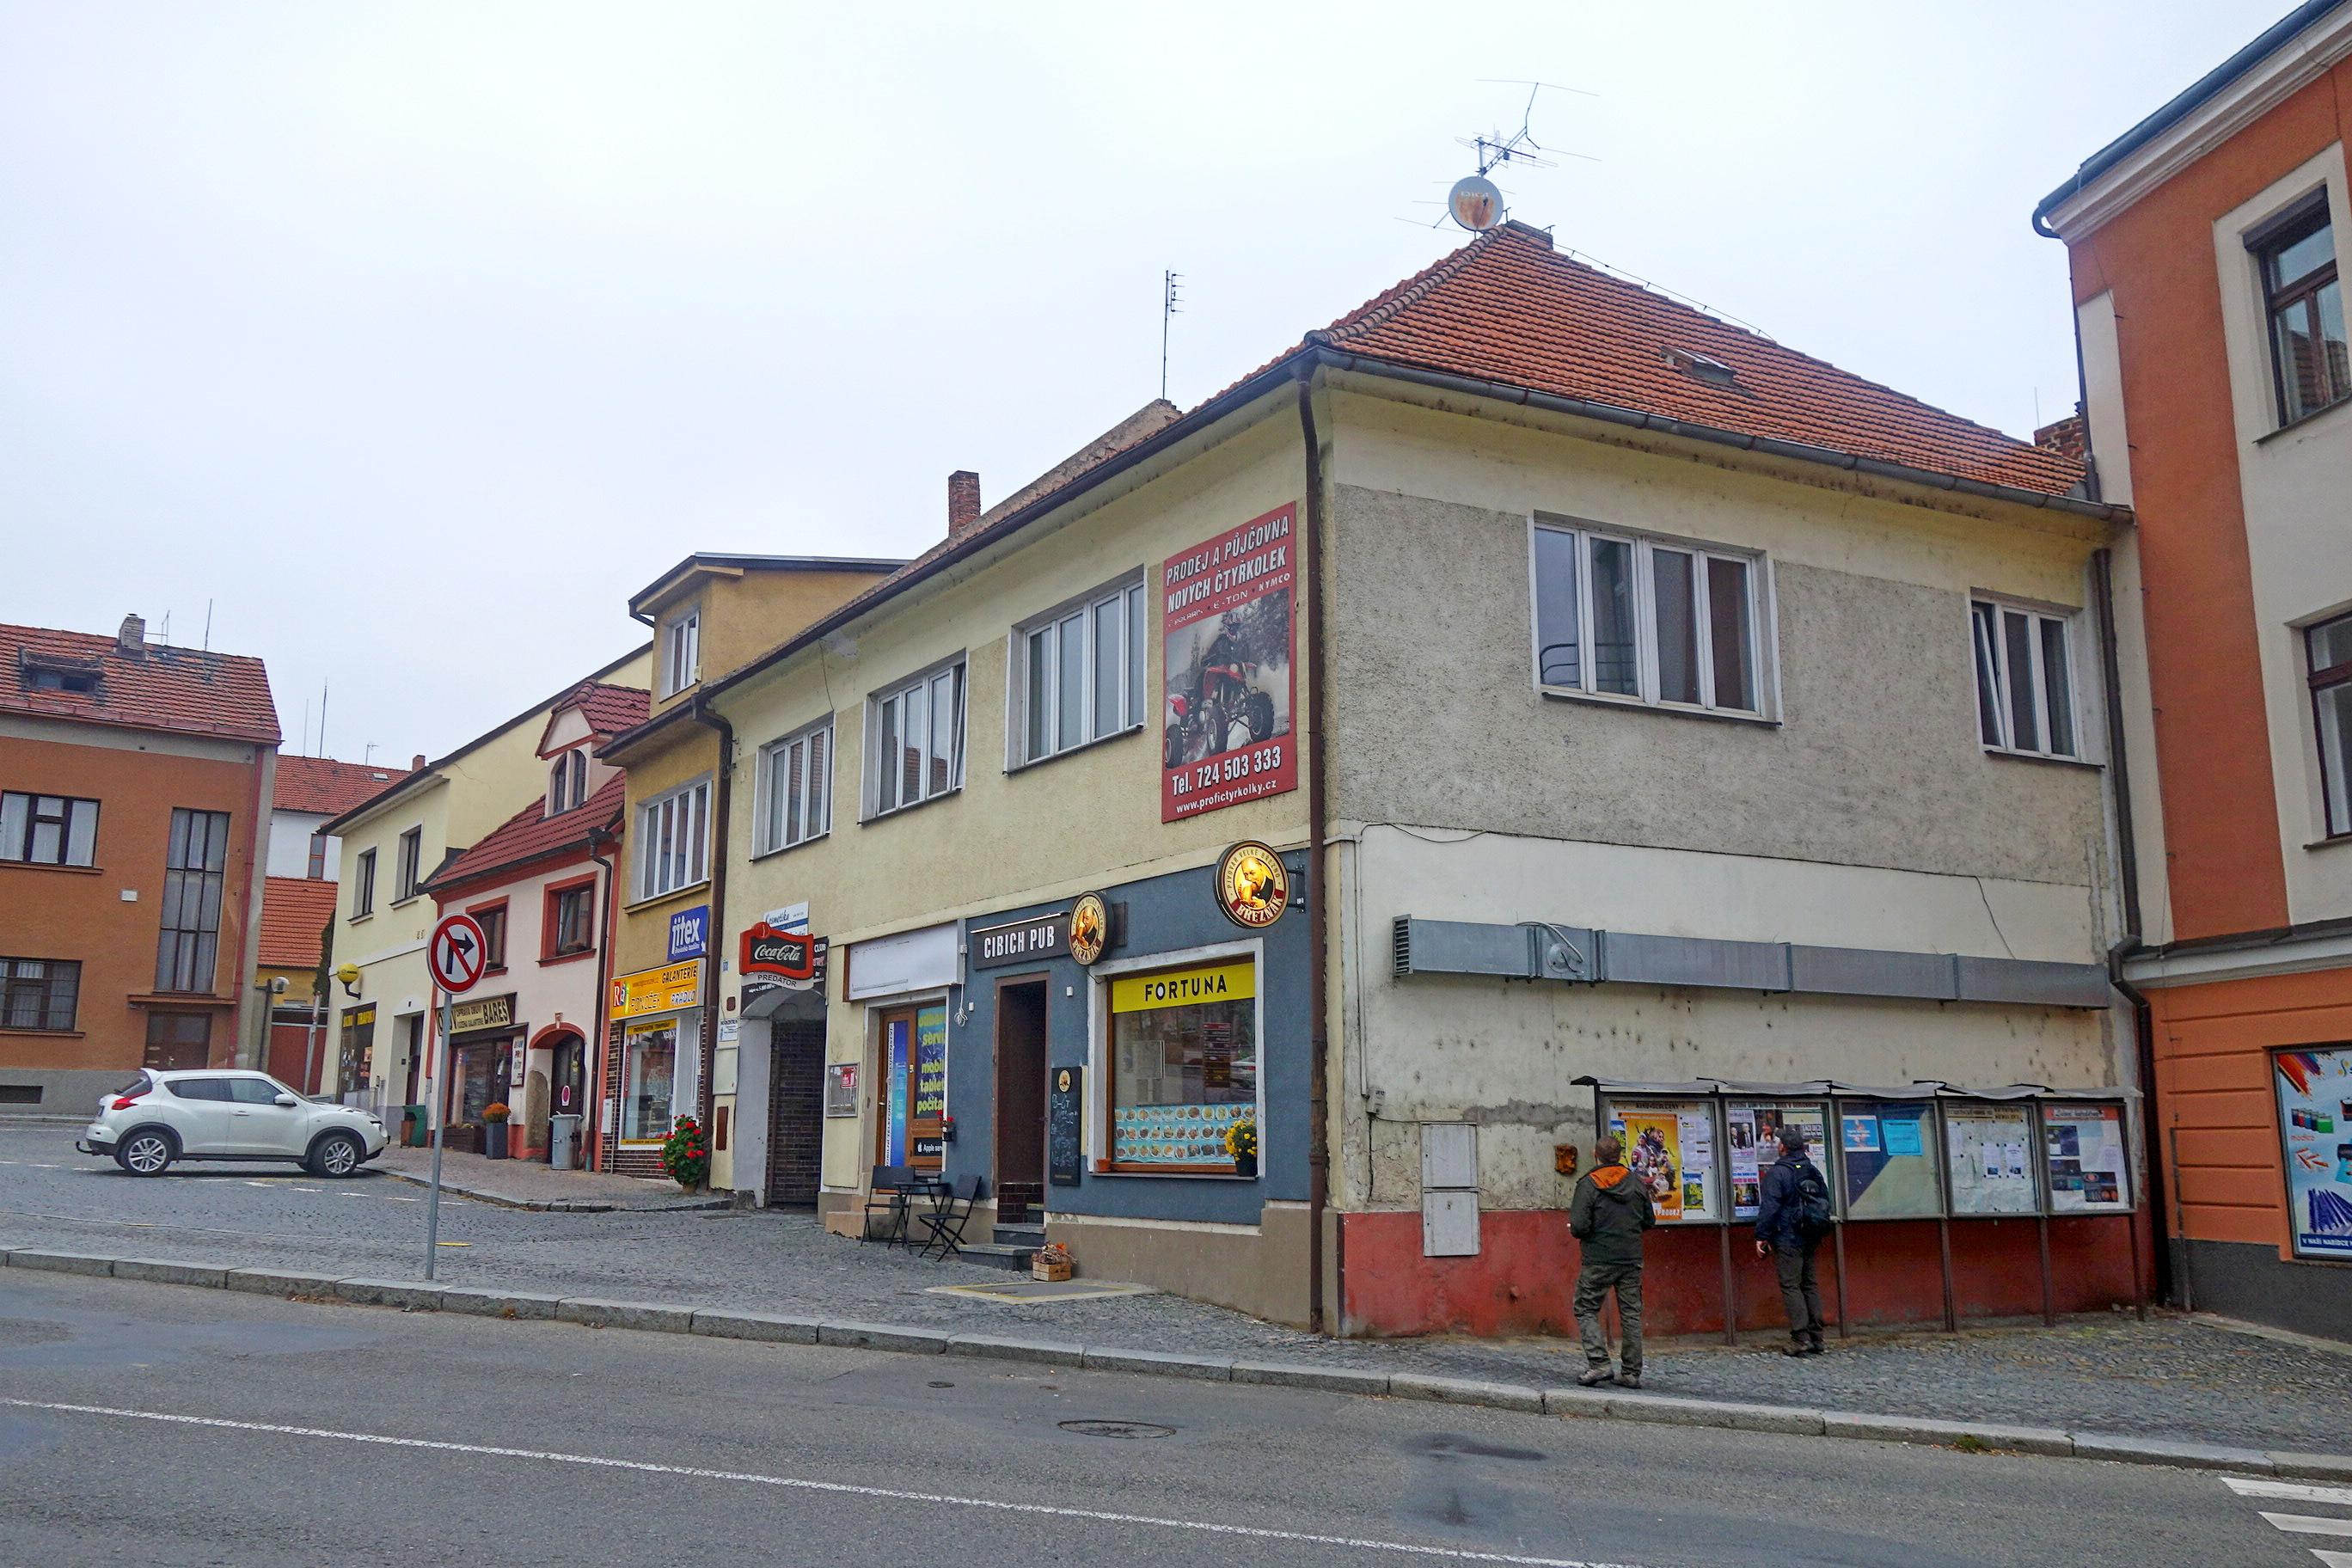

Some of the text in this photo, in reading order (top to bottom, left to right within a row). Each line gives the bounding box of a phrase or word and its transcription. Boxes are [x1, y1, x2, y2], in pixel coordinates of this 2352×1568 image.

[1167, 516, 1289, 587] PRODEJ A PŮJČOVNA
[1167, 546, 1287, 614] NOVÝCH ČTYŘKOLEK
[1259, 573, 1290, 591] KYMCO
[1172, 745, 1282, 796] Tel. 724 503 333
[1176, 780, 1277, 813] www.profictyrkolky.cz
[983, 925, 1055, 959] CIBICH PUB
[661, 965, 698, 984] GALANTERIE
[757, 973, 797, 988] PREDATOR
[1144, 974, 1228, 1002] FORTUNA
[922, 1030, 946, 1047] servi
[922, 1057, 945, 1075] mobil
[920, 1078, 945, 1093] tablet
[917, 1094, 943, 1115] počíta
[923, 1143, 935, 1154] Apple
